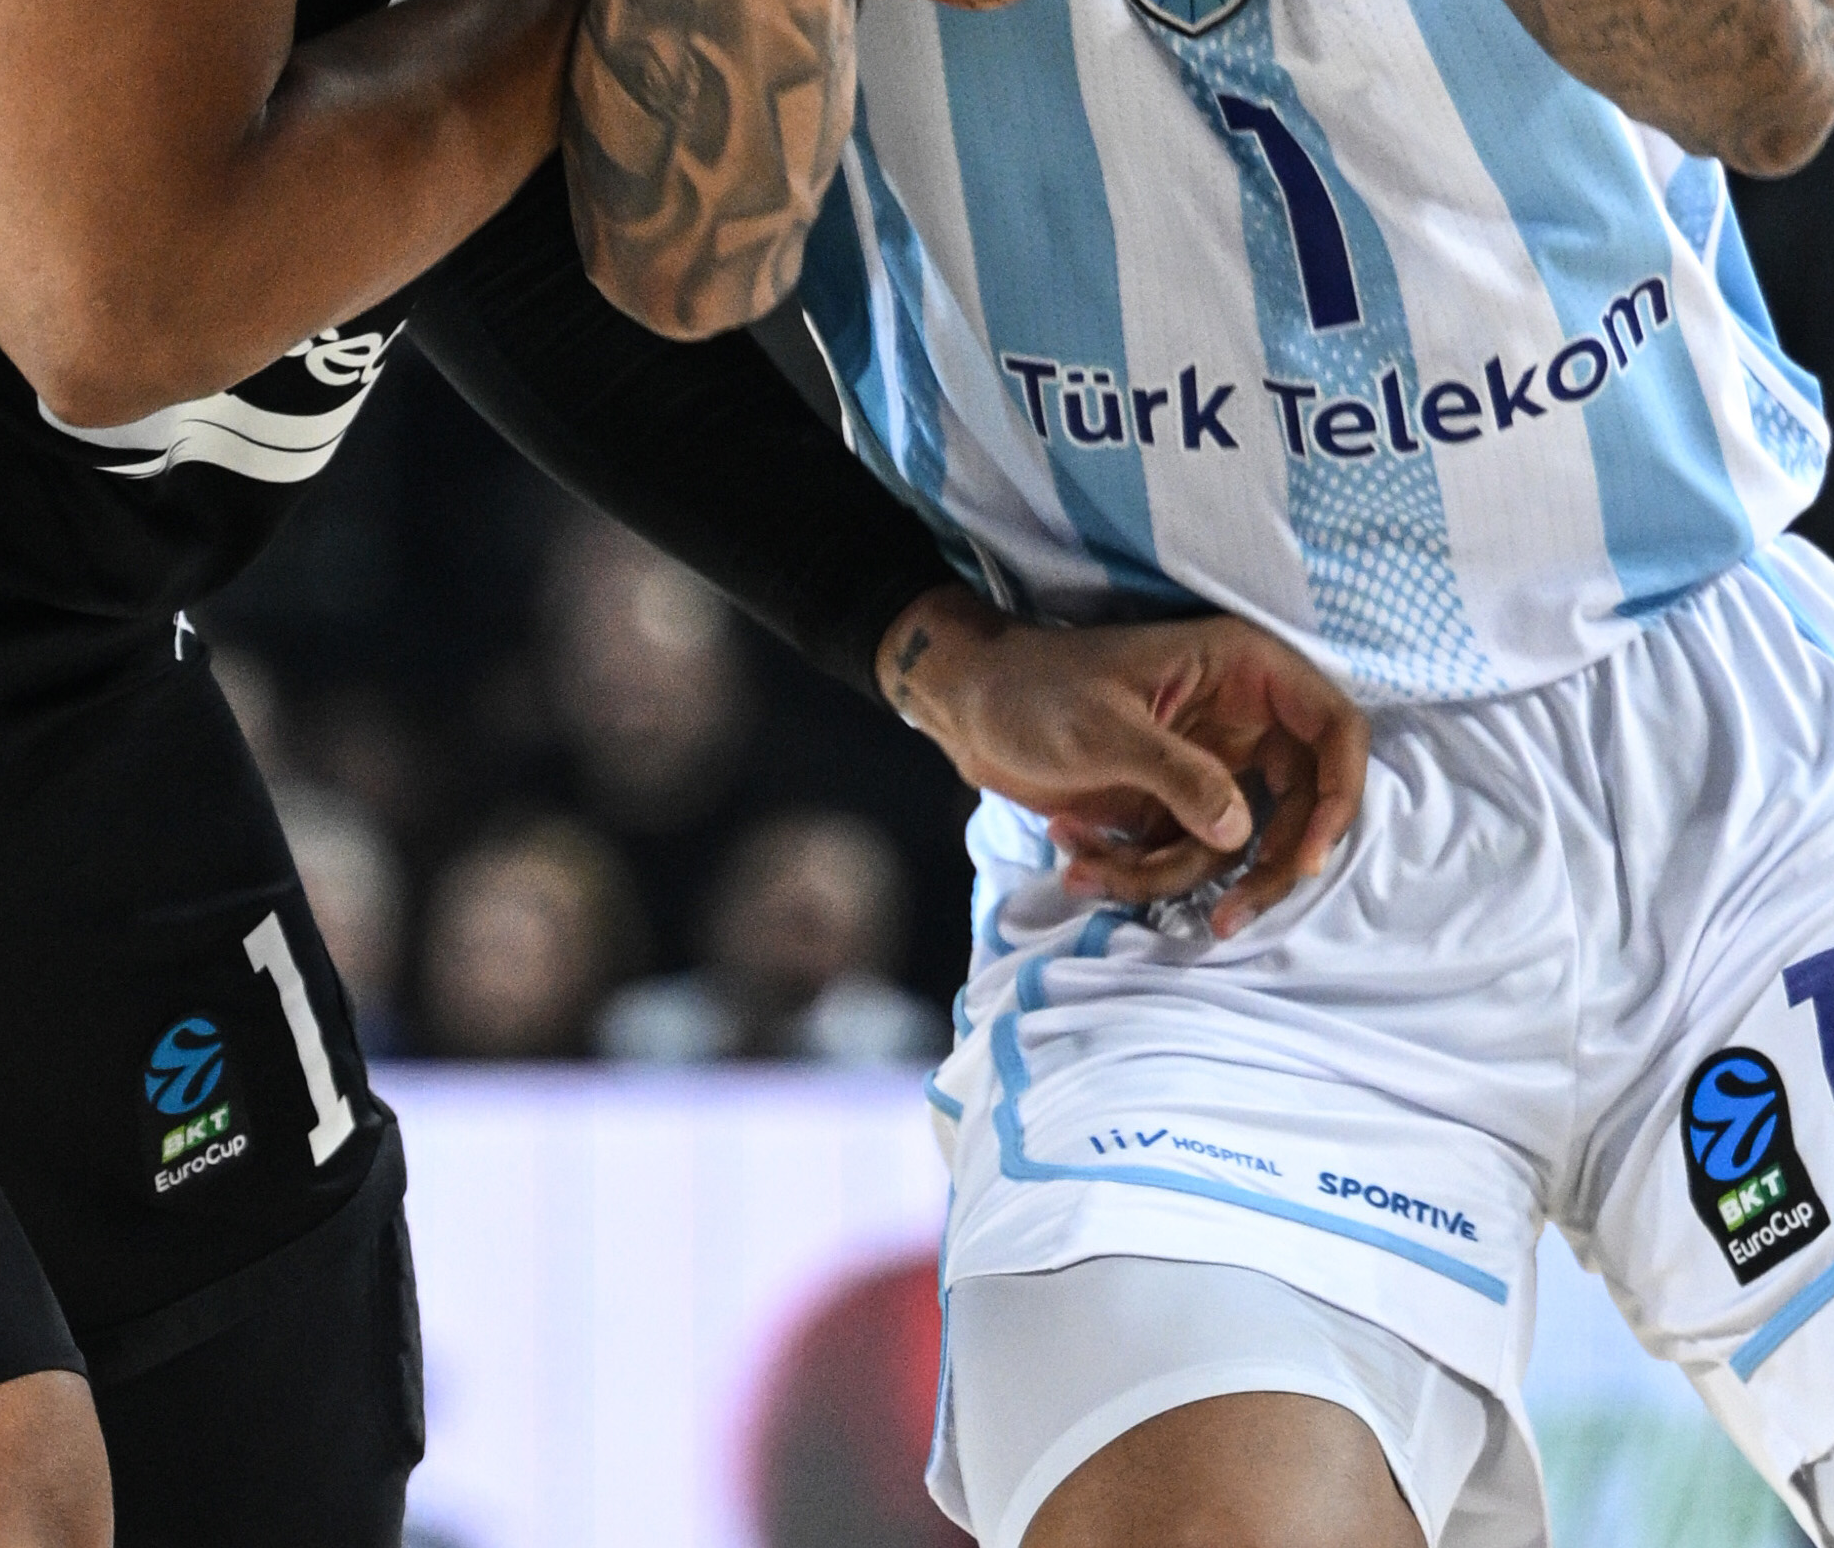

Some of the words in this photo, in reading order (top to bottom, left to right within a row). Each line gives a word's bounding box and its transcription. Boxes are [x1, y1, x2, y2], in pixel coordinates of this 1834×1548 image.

[1217, 94, 1361, 332] 1
[1001, 354, 1240, 453] Türk
[1264, 274, 1671, 455] Telekom
[243, 910, 355, 1167] 1
[153, 1134, 248, 1193] EuroCup
[162, 1105, 229, 1160] BKT
[1172, 1135, 1284, 1178] HOSPITAL
[1718, 1166, 1786, 1229] BKT
[1727, 1201, 1814, 1266] EuroCup
